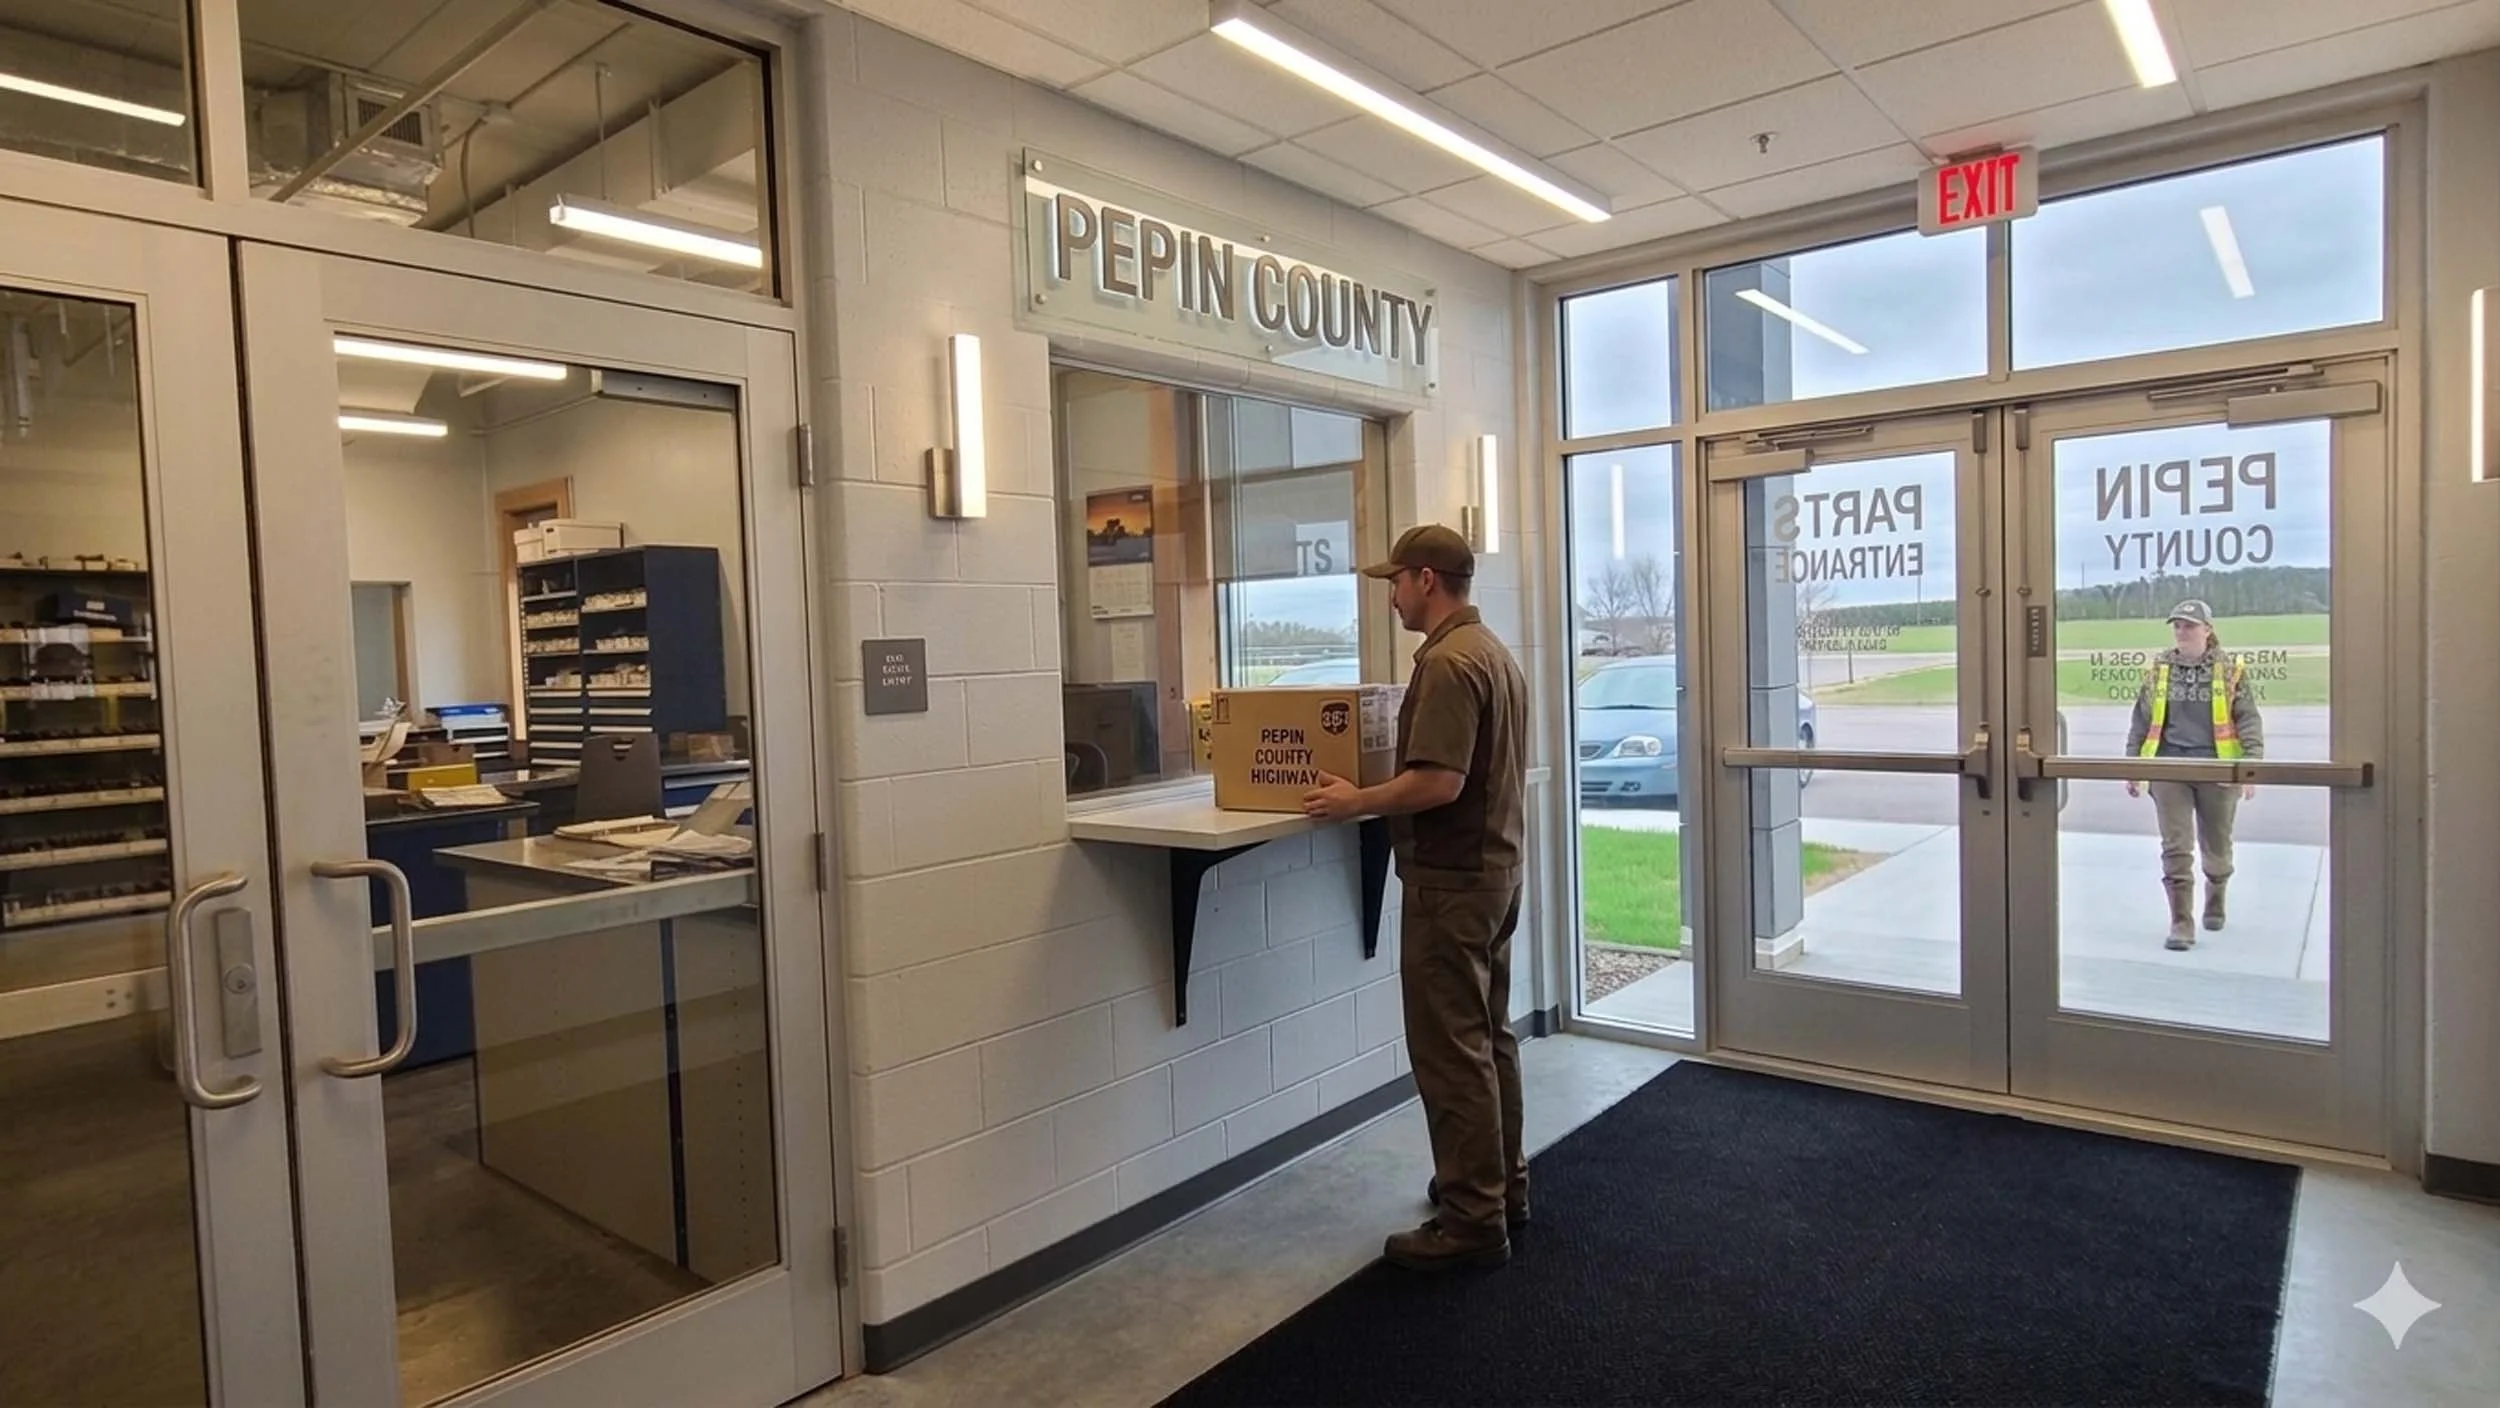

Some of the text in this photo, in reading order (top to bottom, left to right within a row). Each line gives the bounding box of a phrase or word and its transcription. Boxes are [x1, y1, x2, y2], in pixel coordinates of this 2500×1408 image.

[1939, 152, 2019, 225] EXIT
[1055, 193, 1432, 366] PEPIN COUNTY
